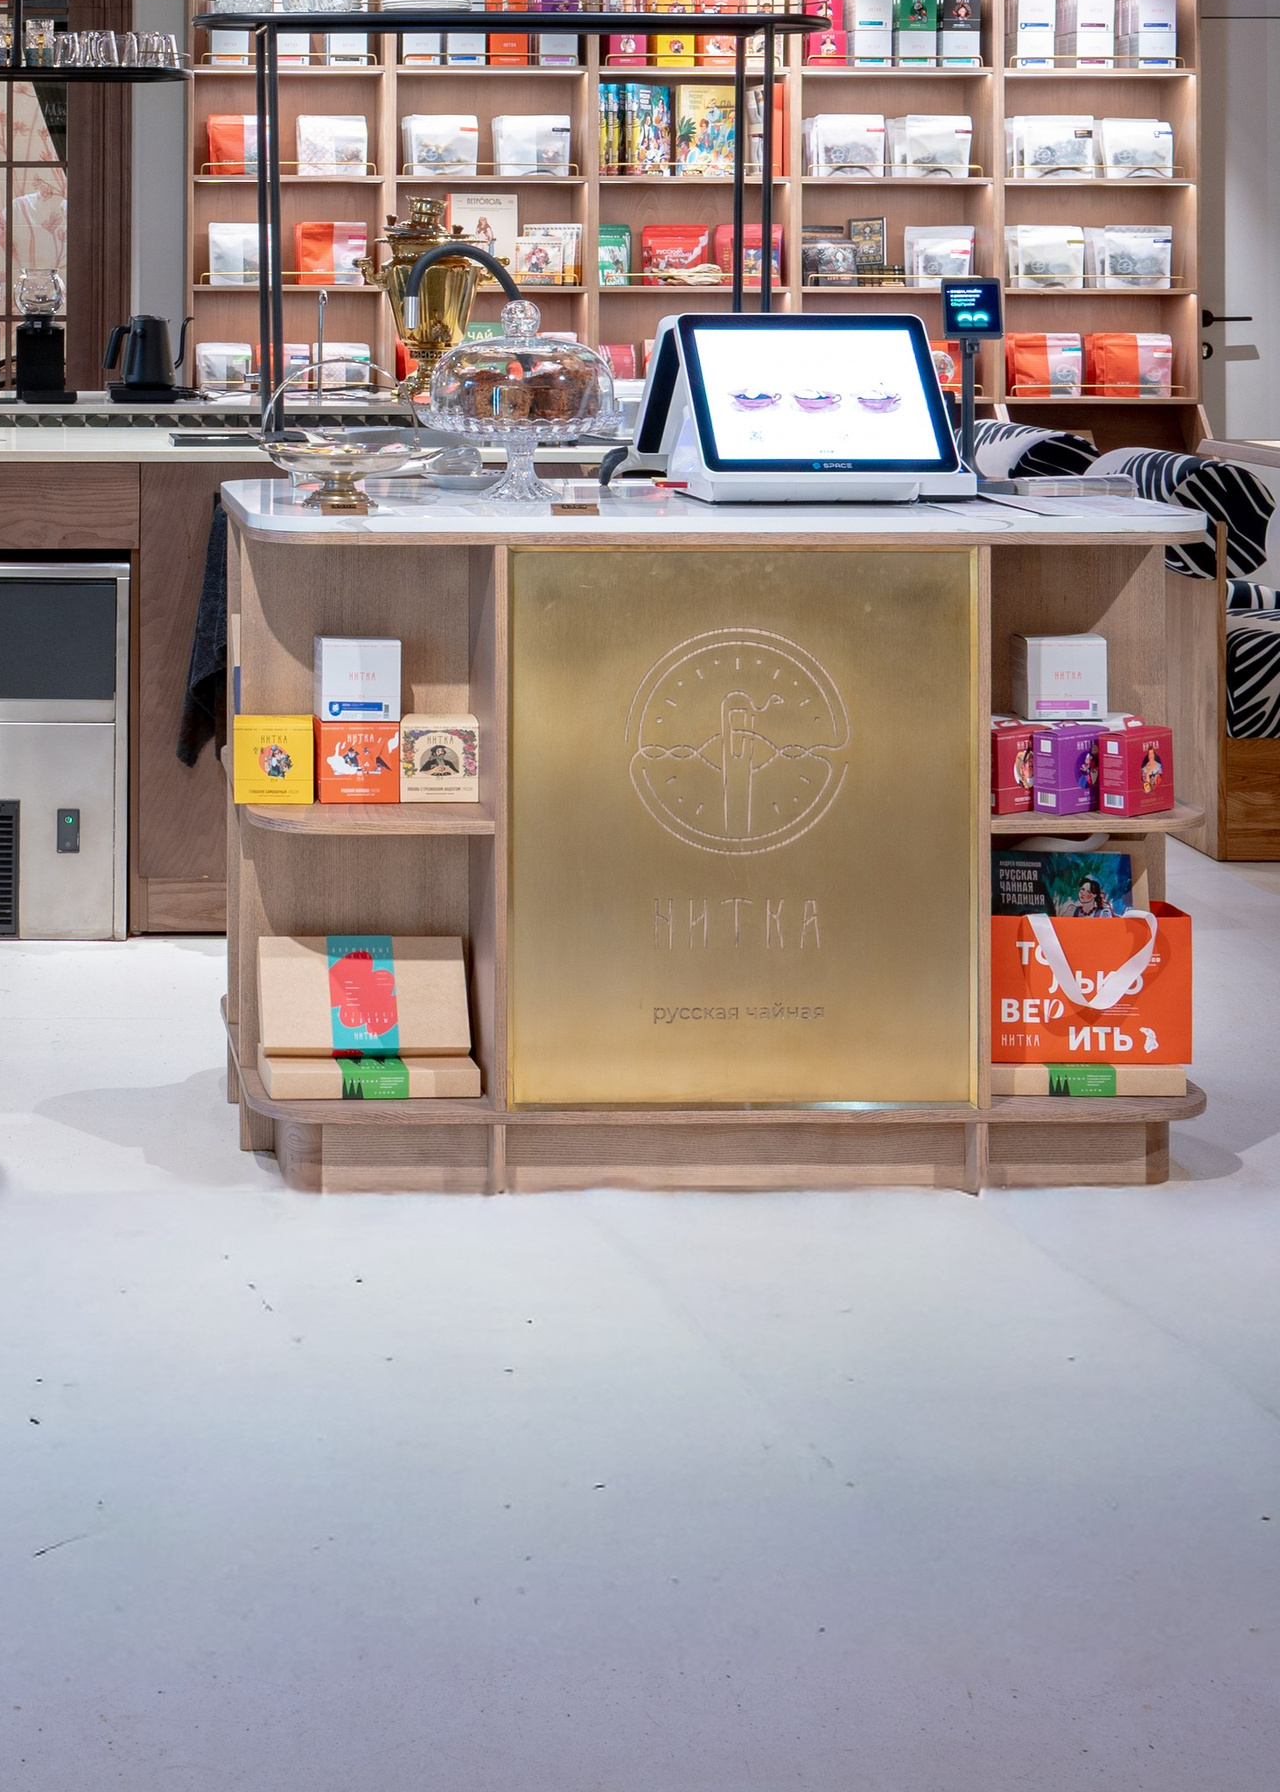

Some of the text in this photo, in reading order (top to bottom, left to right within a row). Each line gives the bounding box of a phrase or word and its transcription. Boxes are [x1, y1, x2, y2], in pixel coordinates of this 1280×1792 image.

[999, 869, 1038, 881] РУССКАЯ
[999, 879, 1034, 892] ЧАЙНАЯ
[1001, 893, 1045, 906] ТРАДИЦИЯ
[653, 897, 821, 950] НИТКА
[653, 1002, 825, 1024] русская чайная
[1001, 998, 1065, 1023] ВЕР
[1001, 1034, 1040, 1047] НИТКА
[1068, 1026, 1134, 1052] ИТЬ
